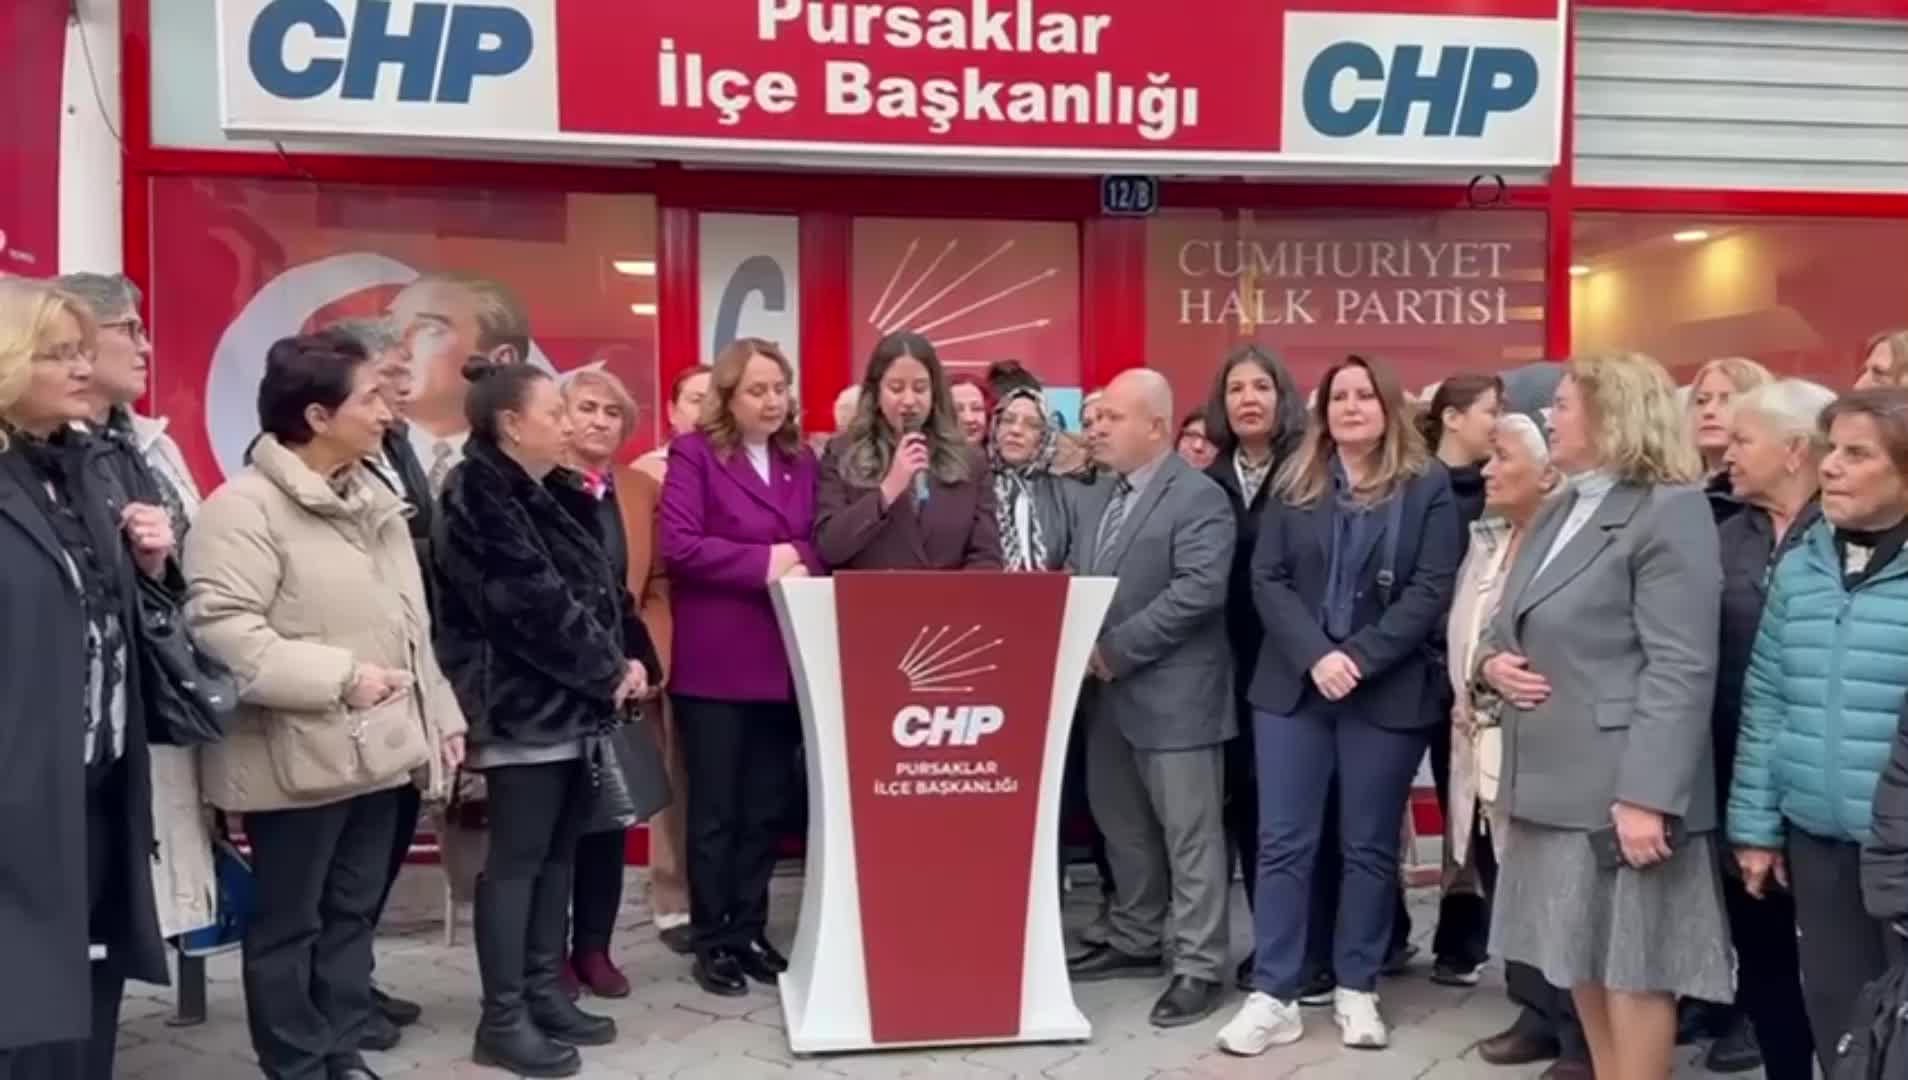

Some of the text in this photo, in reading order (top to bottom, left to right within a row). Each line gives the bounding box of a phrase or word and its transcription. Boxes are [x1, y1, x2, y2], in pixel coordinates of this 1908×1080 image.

[757, 0, 1111, 54] Pursaklar
[248, 0, 534, 103] CHP
[658, 38, 1198, 140] İlçe Başkanlığı
[1302, 41, 1539, 138] CHP
[1109, 180, 1150, 209] 12/B
[1178, 238, 1511, 278] CUMHURİYET
[1178, 286, 1508, 325] HALK PARTİSİ
[892, 705, 1005, 747] CHP
[874, 776, 1019, 797] İLÇE BAŞKANLIĞI
[895, 760, 998, 776] PURSAKLAR
